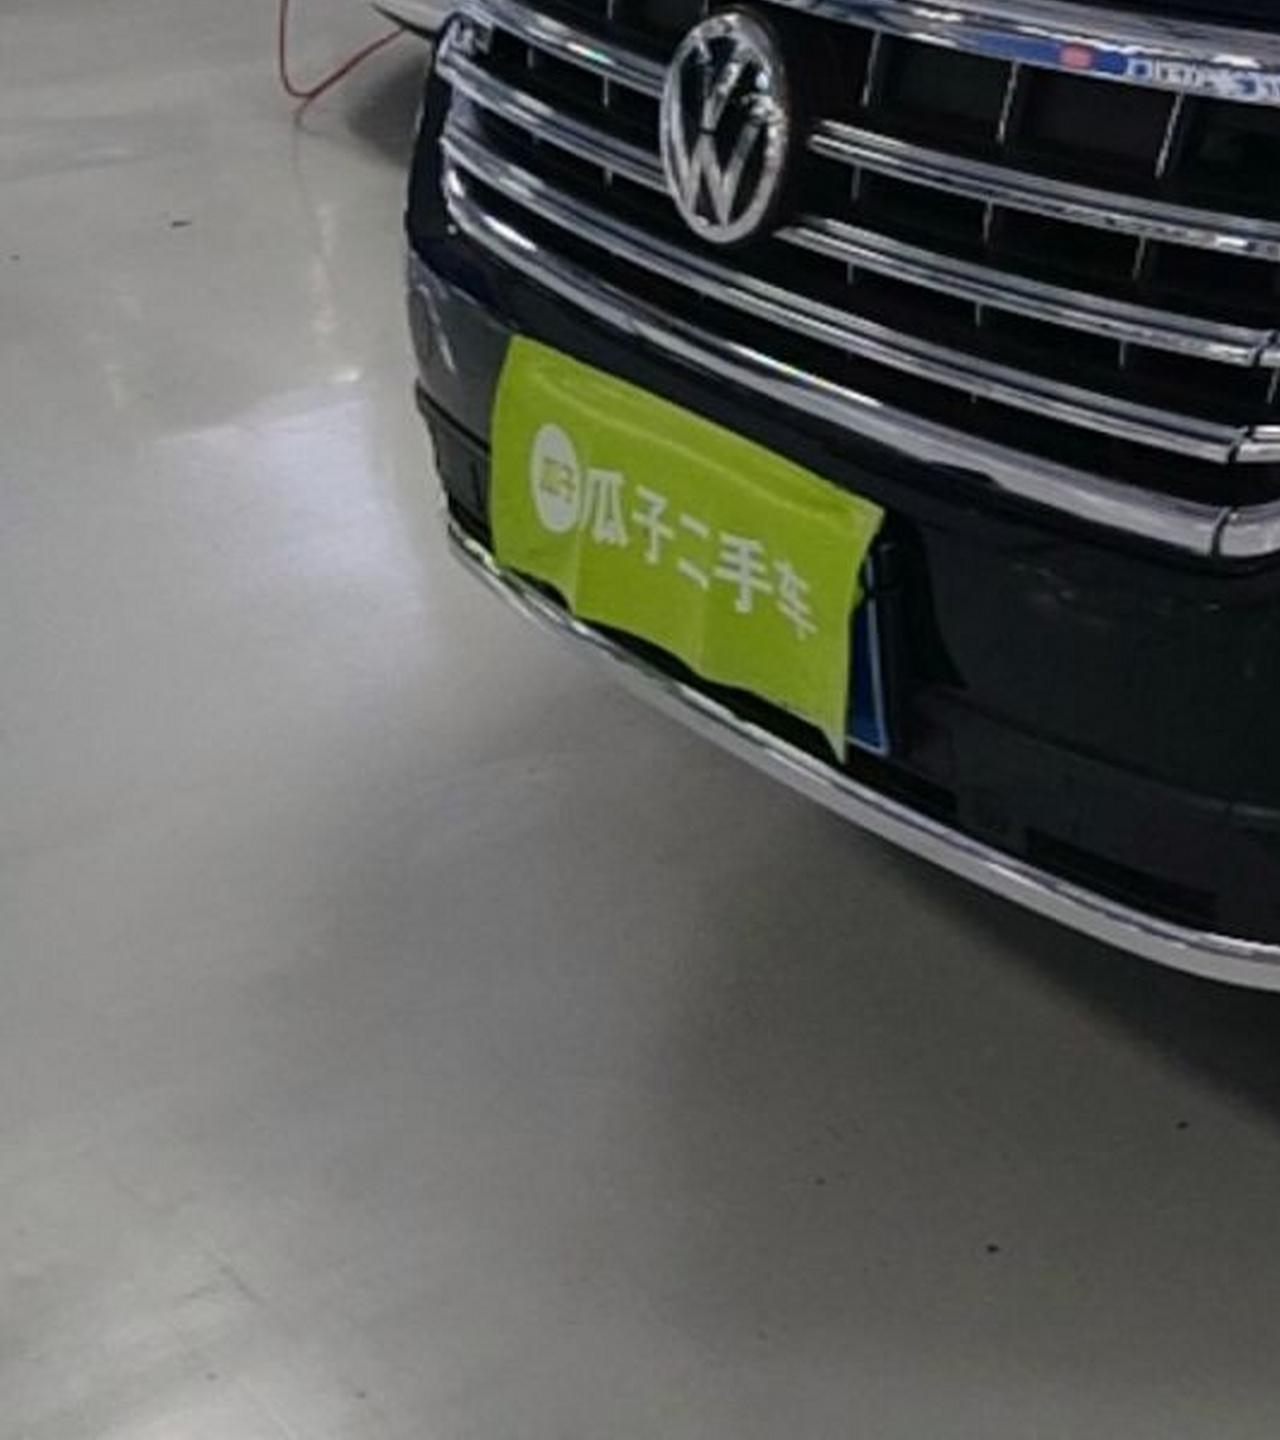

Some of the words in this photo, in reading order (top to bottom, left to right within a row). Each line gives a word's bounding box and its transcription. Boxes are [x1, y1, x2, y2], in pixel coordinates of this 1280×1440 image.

[578, 467, 817, 641] 瓜子二手车
